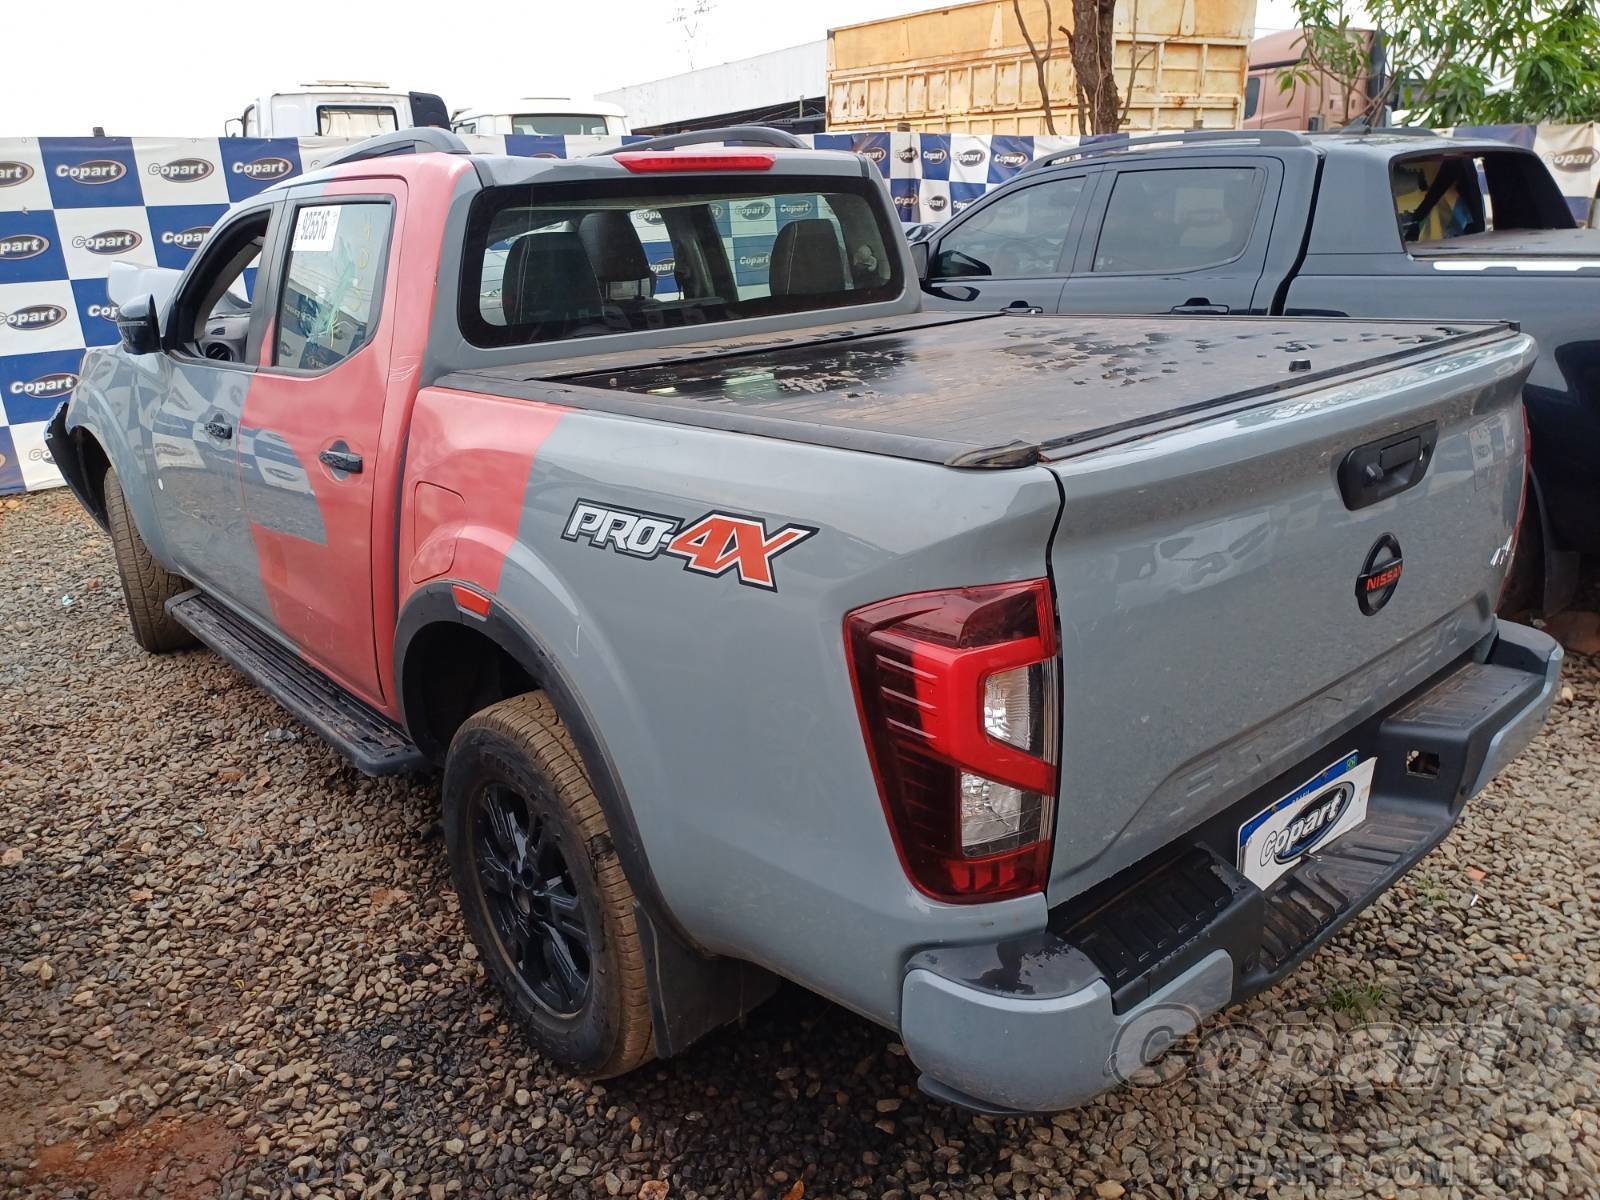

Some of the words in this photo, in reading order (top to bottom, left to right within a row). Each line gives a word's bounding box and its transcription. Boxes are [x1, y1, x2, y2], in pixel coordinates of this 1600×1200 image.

[0, 167, 22, 180] art
[56, 163, 118, 180] Copart
[148, 162, 208, 178] Copart
[232, 160, 286, 176] Copart
[636, 210, 662, 221] Copa
[0, 238, 40, 255] part
[72, 234, 134, 252] Copart
[88, 305, 119, 318] Cop
[10, 376, 73, 394] Copart
[1260, 787, 1345, 867] Copart
